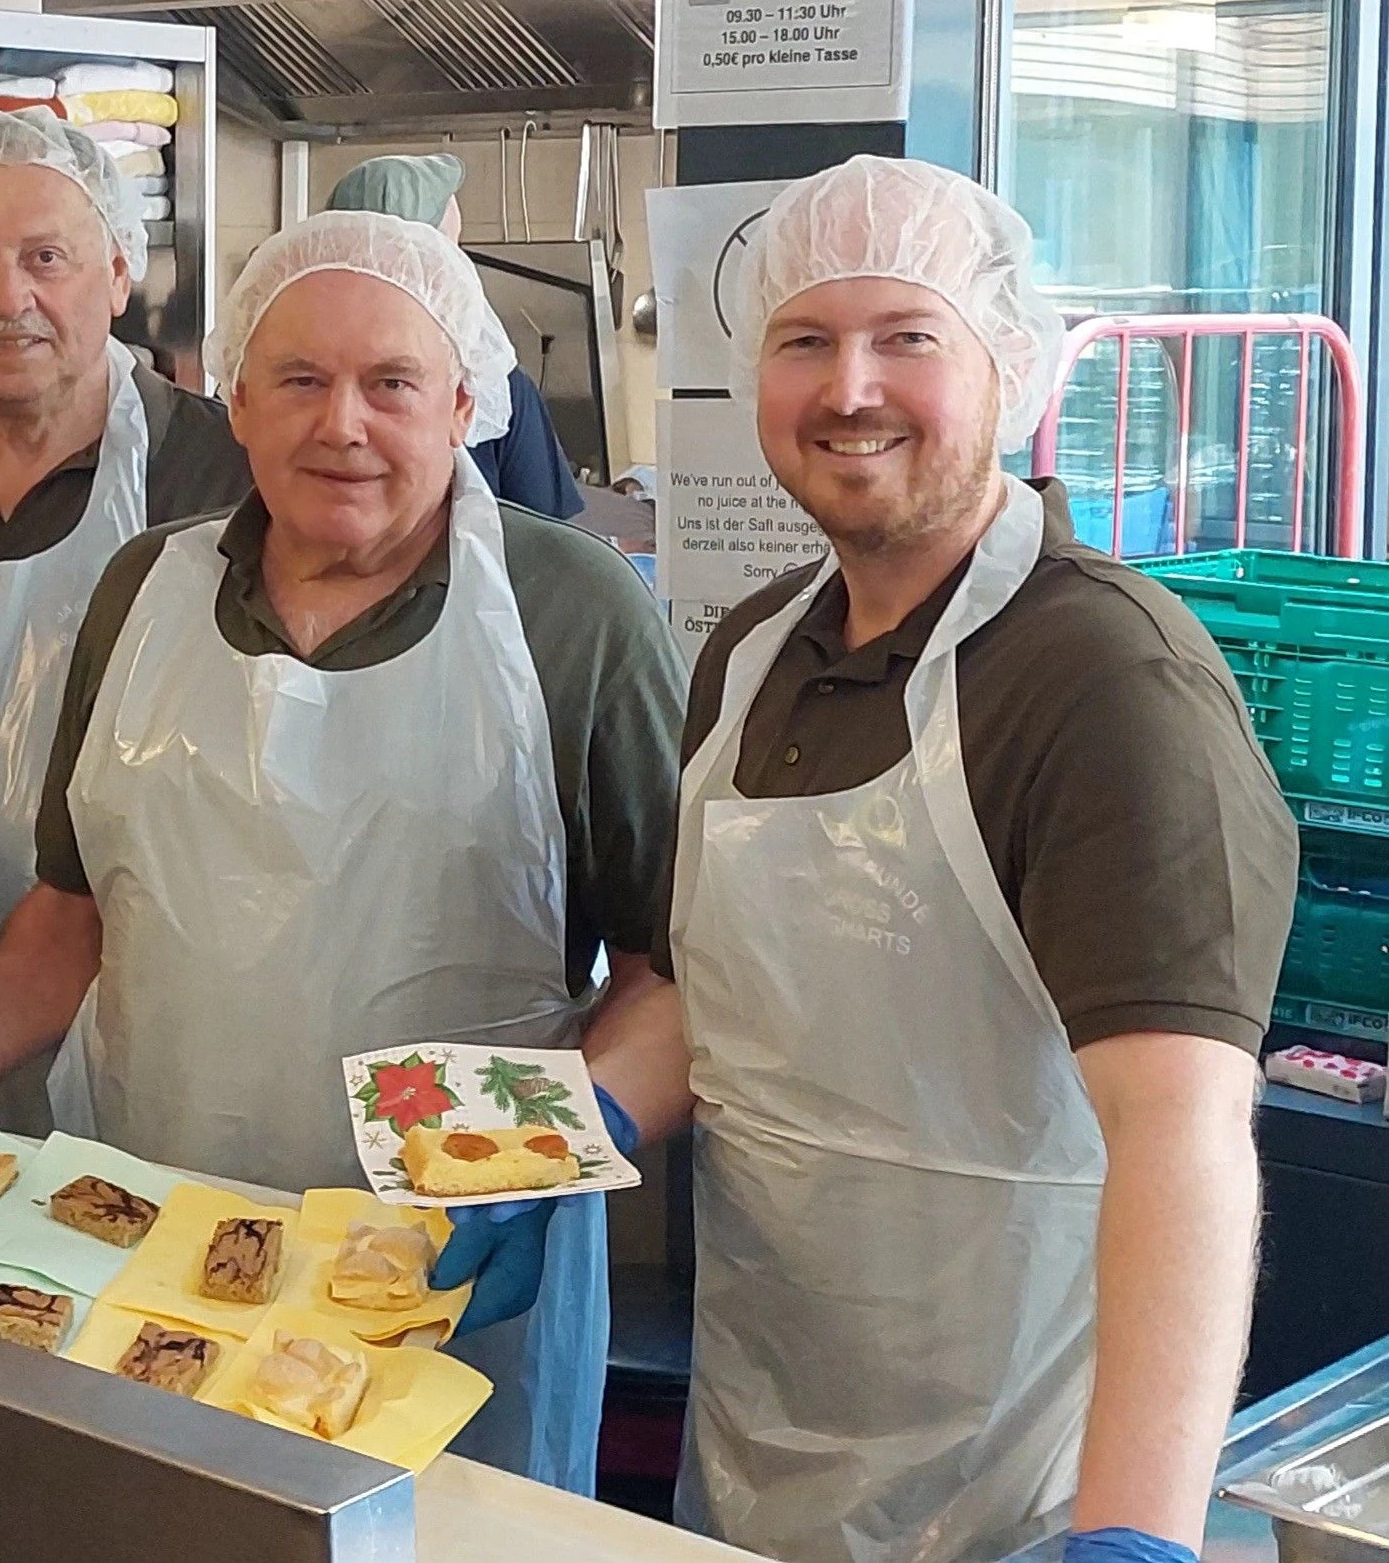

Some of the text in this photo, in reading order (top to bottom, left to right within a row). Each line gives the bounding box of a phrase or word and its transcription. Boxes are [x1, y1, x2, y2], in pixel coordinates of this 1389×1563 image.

[726, 9, 762, 23] 09.30
[820, 4, 846, 18] Uhr
[721, 31, 756, 44] 15.00
[773, 28, 809, 41] 18.00
[813, 26, 840, 40] Uhr
[703, 48, 858, 68] 0,50€ pro kleine Tasse
[670, 472, 708, 487] We've
[712, 475, 732, 487] run
[736, 475, 756, 487] out
[760, 474, 772, 487] of
[698, 496, 713, 507] no
[716, 496, 747, 511] juice
[751, 496, 762, 508] at
[766, 496, 787, 508] the
[677, 517, 702, 530] Uns
[706, 517, 720, 530] ist
[723, 517, 744, 531] der
[748, 518, 773, 531] Saft
[683, 538, 725, 551] derzeit
[728, 538, 755, 551] also
[759, 539, 798, 553] keiner
[743, 564, 778, 578] Sorry
